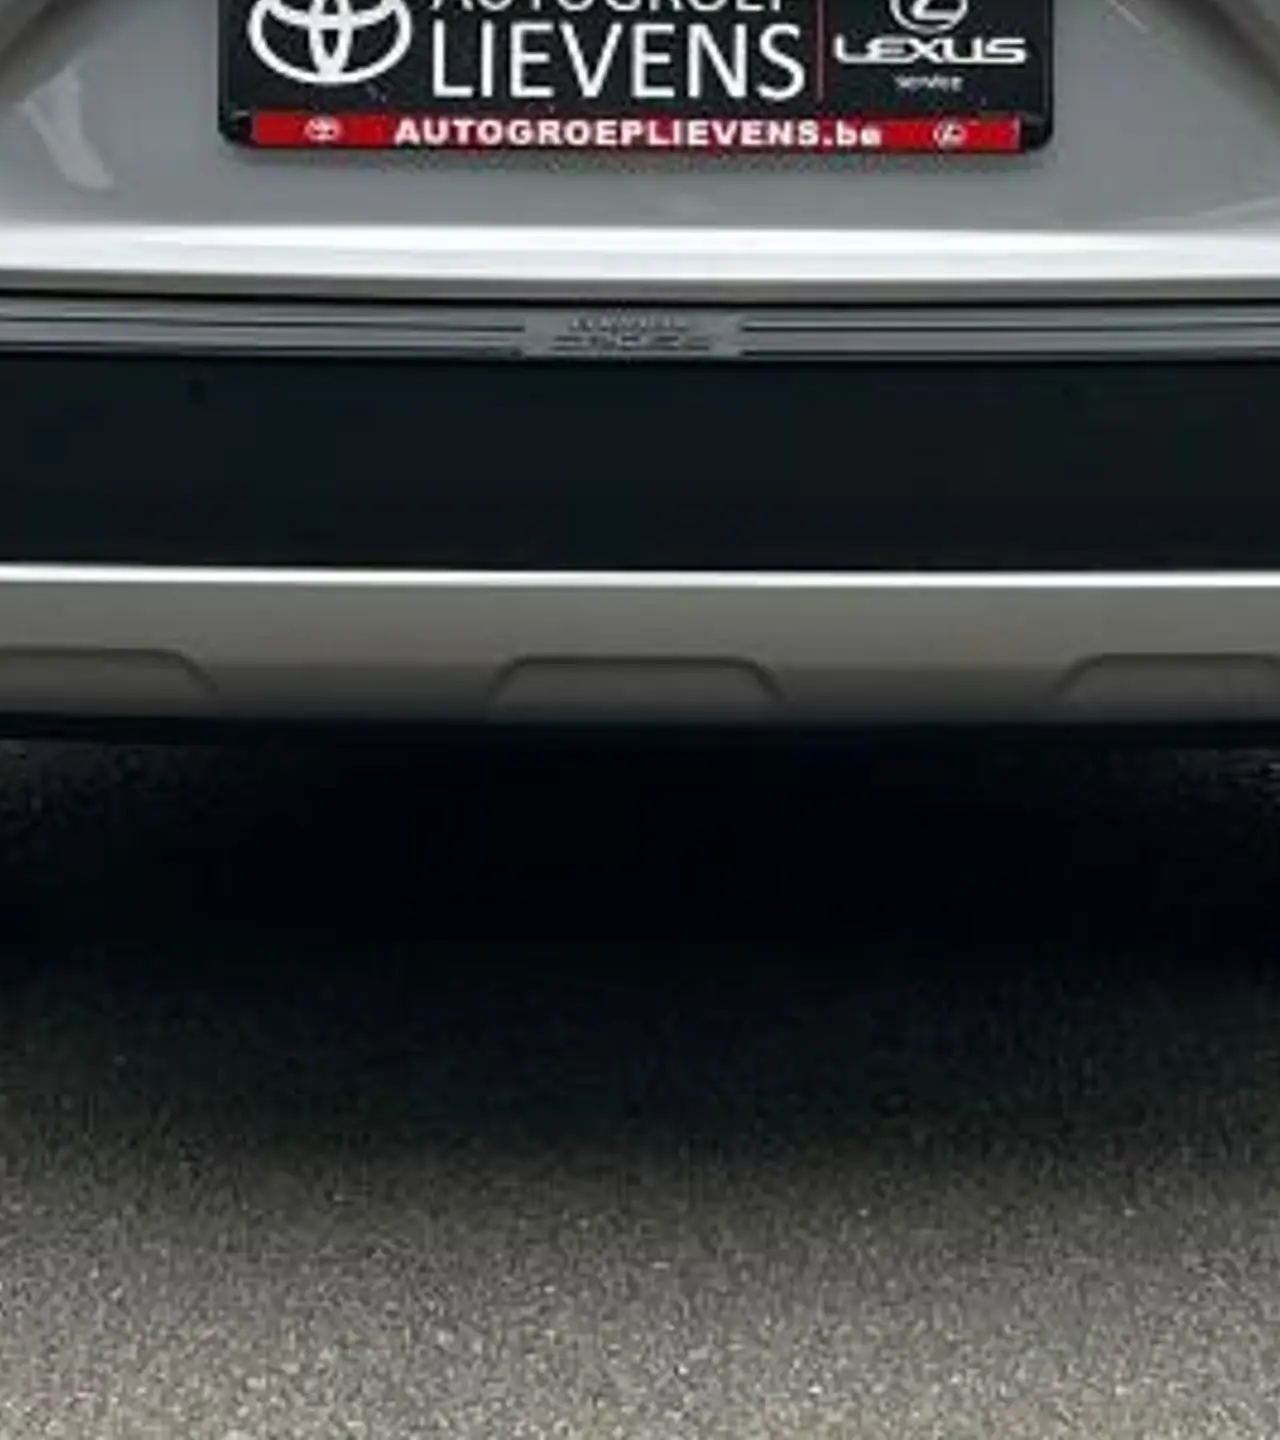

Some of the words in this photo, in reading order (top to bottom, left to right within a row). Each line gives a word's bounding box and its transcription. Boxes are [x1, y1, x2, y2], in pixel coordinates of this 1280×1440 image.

[431, 20, 807, 100] LIEVENS
[833, 33, 1027, 64] LEXUS
[394, 117, 883, 148] AUTOGROEPLIEVENS.be
